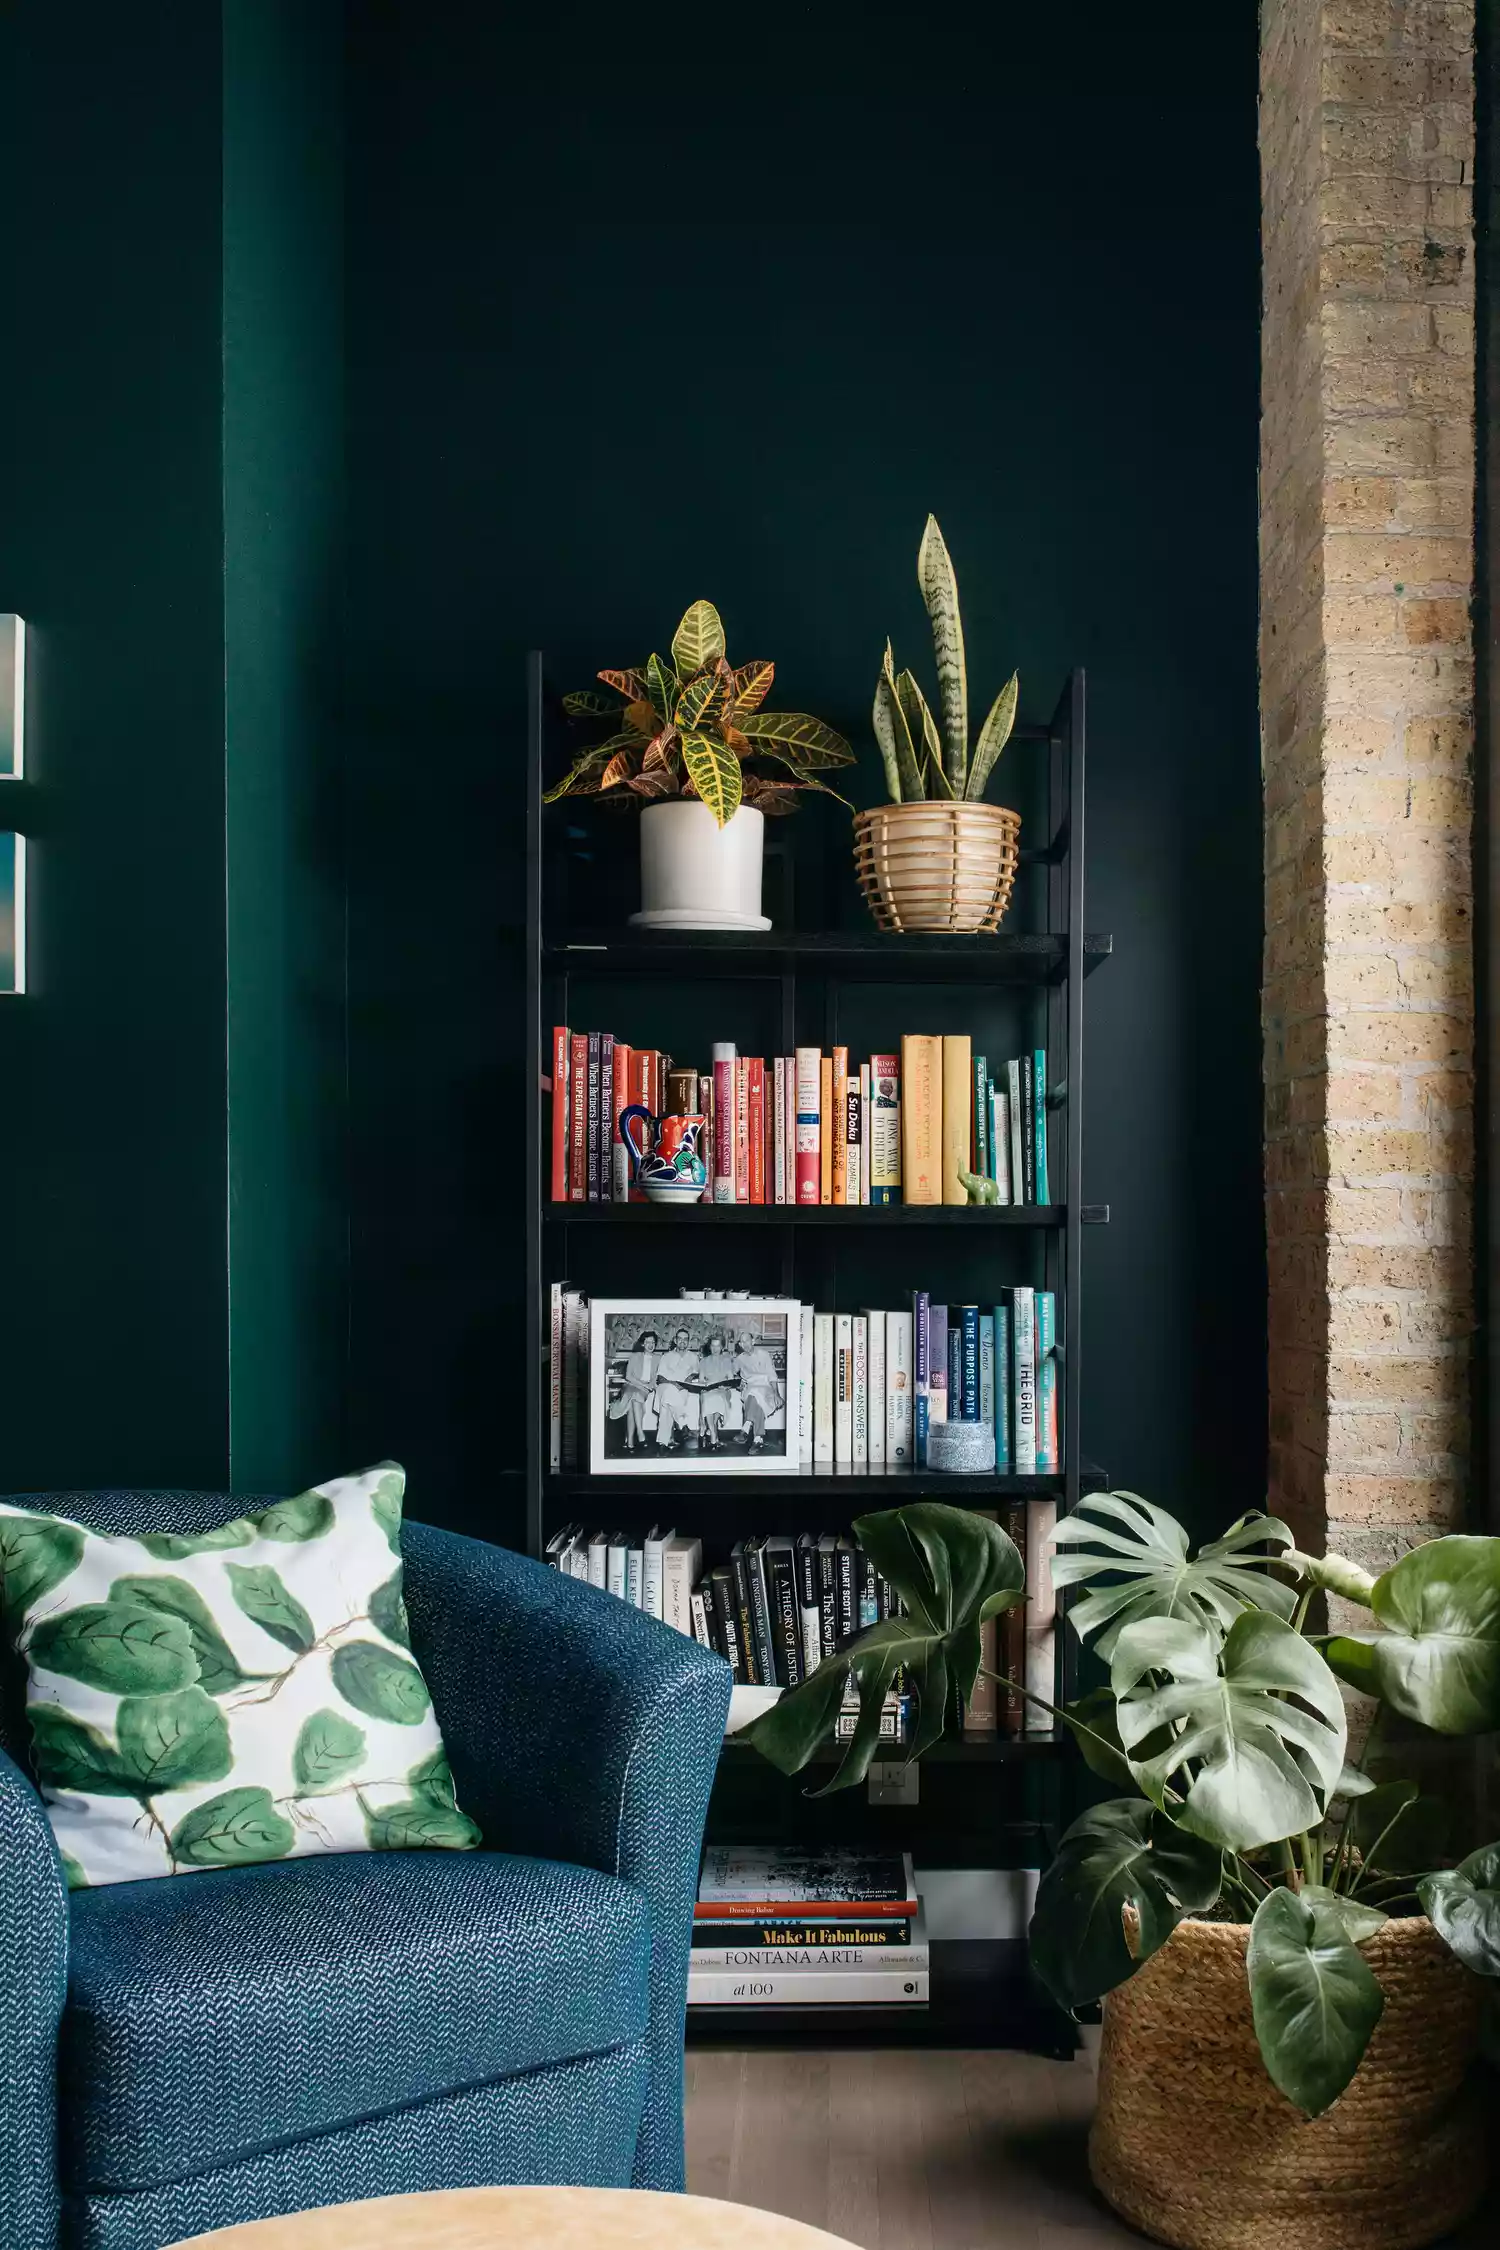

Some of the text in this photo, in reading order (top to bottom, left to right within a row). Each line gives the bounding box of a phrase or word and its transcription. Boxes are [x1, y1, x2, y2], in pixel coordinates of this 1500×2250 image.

[574, 1067, 584, 1079] THE
[574, 1080, 584, 1120] EXPECTANT
[574, 1121, 584, 1147] FATHER
[589, 1062, 598, 1180] When Partners Become Parents
[602, 1064, 612, 1183] When Partners Become Parents
[848, 1097, 858, 1140] Su Doku
[887, 1119, 898, 1174] LONG WALK
[848, 1152, 857, 1190] DUMMIES
[856, 1355, 864, 1383] BOOK
[966, 1321, 975, 1413] THE PURPOSE PATH
[982, 1341, 993, 1370] Dinner
[858, 1384, 863, 1392] OF
[1021, 1362, 1032, 1424] THE GRID
[856, 1393, 864, 1439] ANSWERS
[842, 1555, 850, 1588] STUART
[671, 1579, 680, 1602] DONNA
[824, 1593, 833, 1613] The
[752, 1578, 765, 1638] KINGDOM MAN
[782, 1588, 793, 1629] THEORY
[868, 1602, 874, 1615] ON
[695, 1613, 705, 1644] Robert Fro
[725, 1620, 739, 1668] SOUTH AFRICA
[786, 1632, 795, 1646] OF
[824, 1616, 834, 1639] New
[741, 1623, 751, 1655] Fabulous
[747, 1656, 756, 1684] Future?
[760, 1646, 771, 1687] TONY EVAN
[1008, 1665, 1016, 1707] Vole 89
[729, 1907, 755, 1915] Drawing
[762, 1929, 886, 1944] Make It Fabulous
[725, 1950, 863, 1964] FONTANA ARTE
[733, 1984, 773, 1996] al 100
